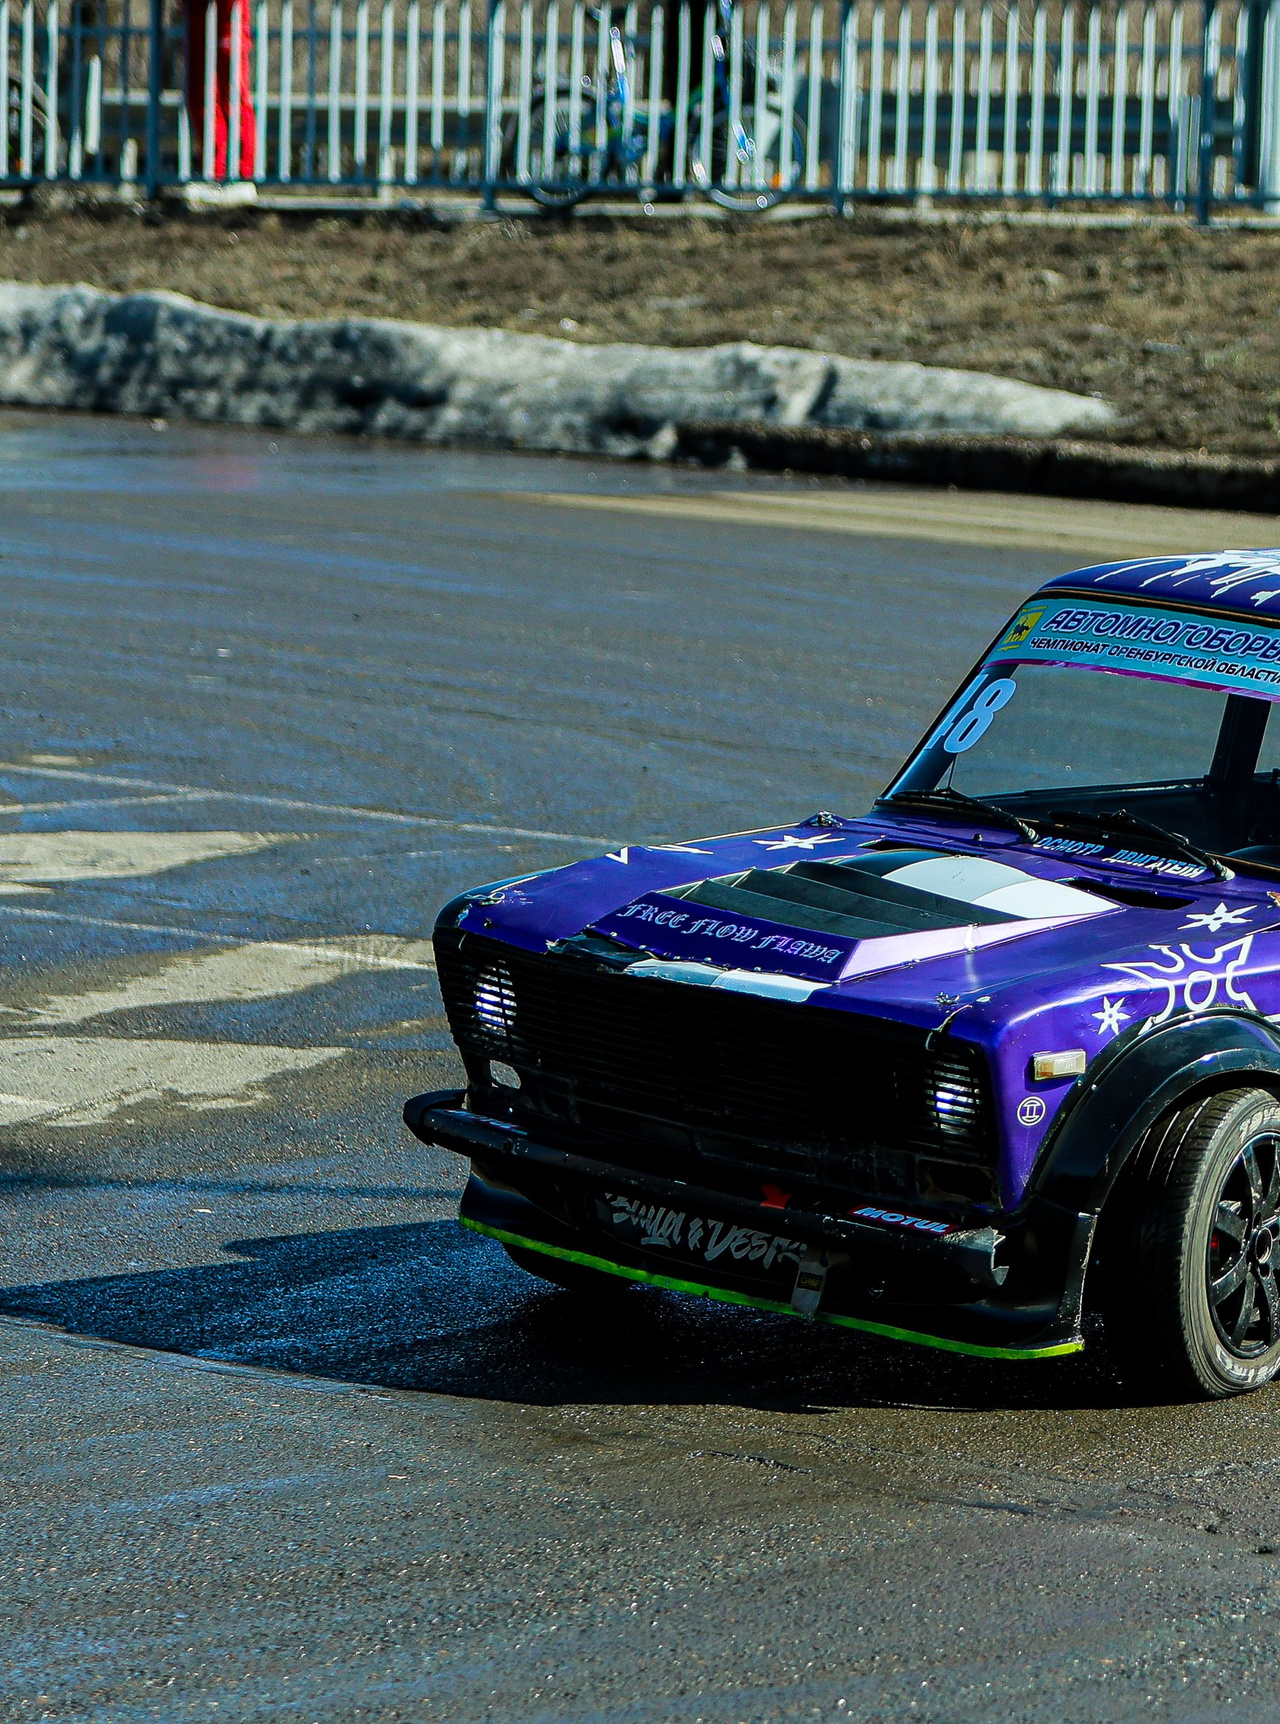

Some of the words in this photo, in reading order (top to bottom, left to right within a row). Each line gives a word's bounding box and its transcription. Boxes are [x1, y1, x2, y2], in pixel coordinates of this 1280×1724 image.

[1030, 637, 1109, 656] ЧЕМПИОНАТ
[1108, 644, 1217, 672] ОРЕНБУРГСКОЙ
[924, 674, 1016, 753] 18
[1033, 836, 1105, 855] ОСМОТР
[1101, 849, 1207, 878] ДВИГАТЕЛЯ
[616, 903, 688, 928] FREE
[681, 918, 759, 943] FLOW
[853, 1207, 950, 1233] MOTUL
